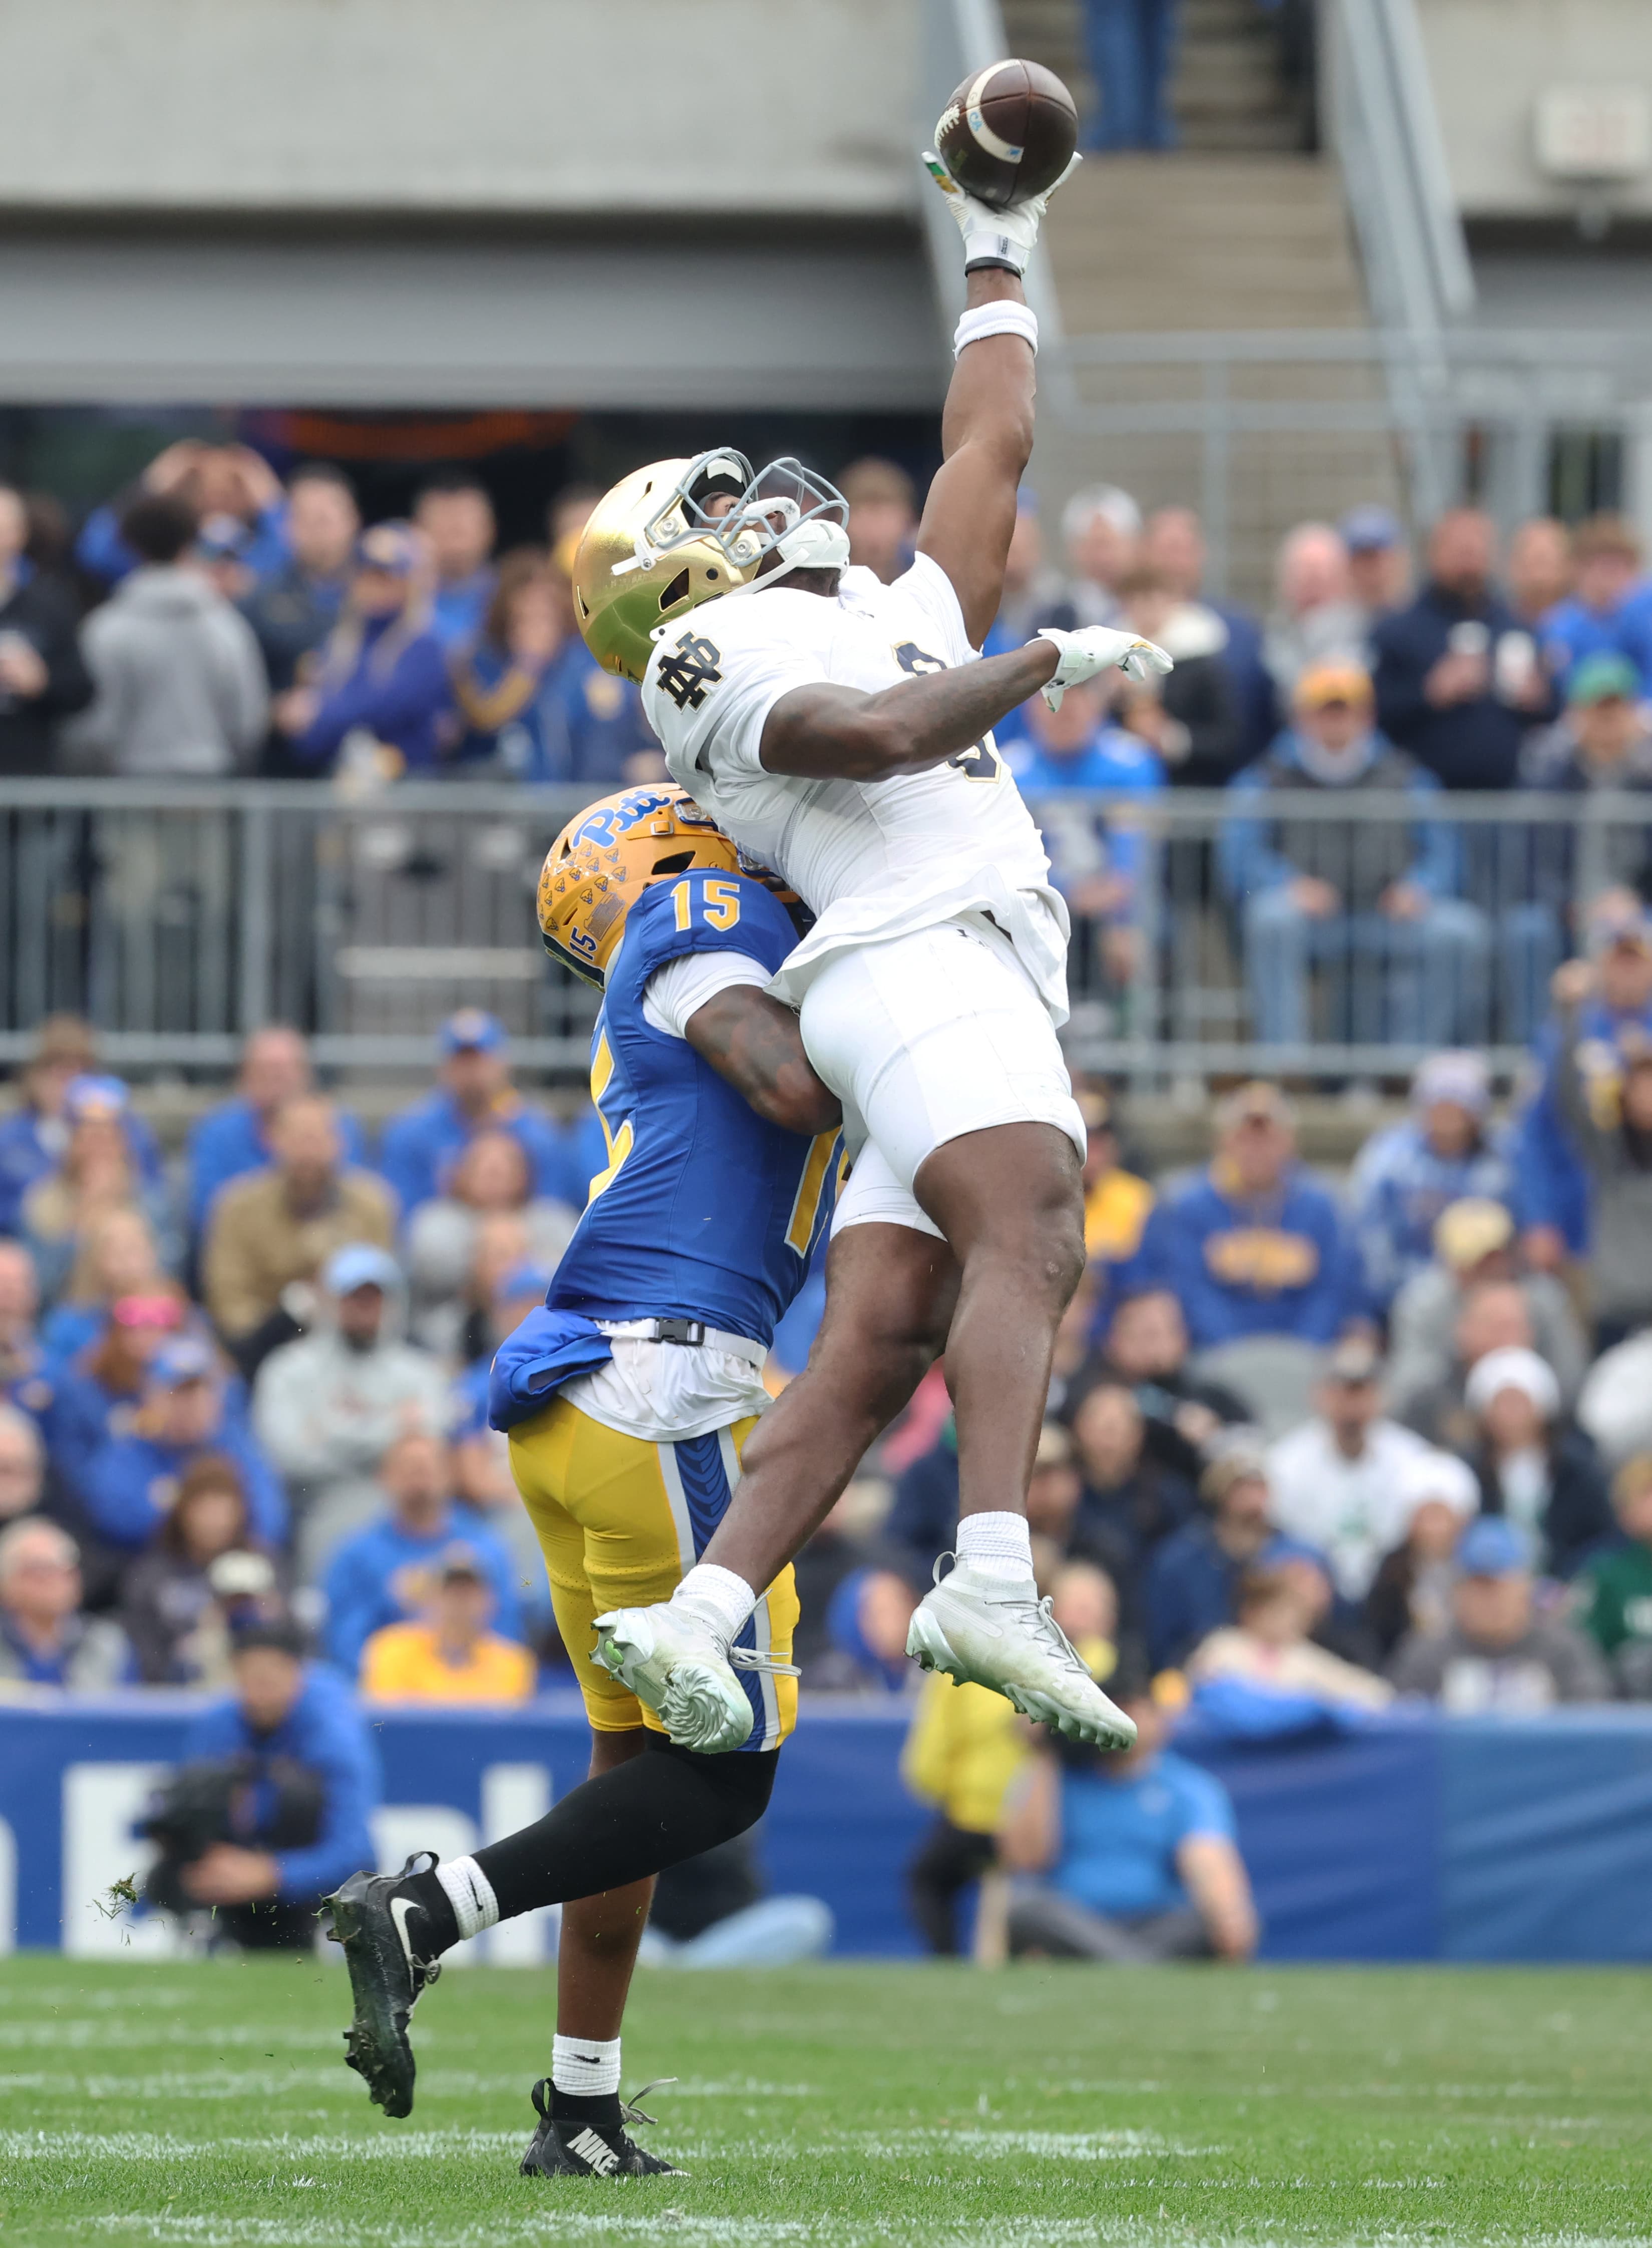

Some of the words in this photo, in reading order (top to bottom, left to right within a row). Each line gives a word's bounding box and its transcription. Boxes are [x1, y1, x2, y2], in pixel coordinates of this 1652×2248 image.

[571, 790, 672, 848] Pitt
[671, 879, 741, 932] 15
[569, 925, 597, 961] 15
[566, 2127, 619, 2177] NIKE
